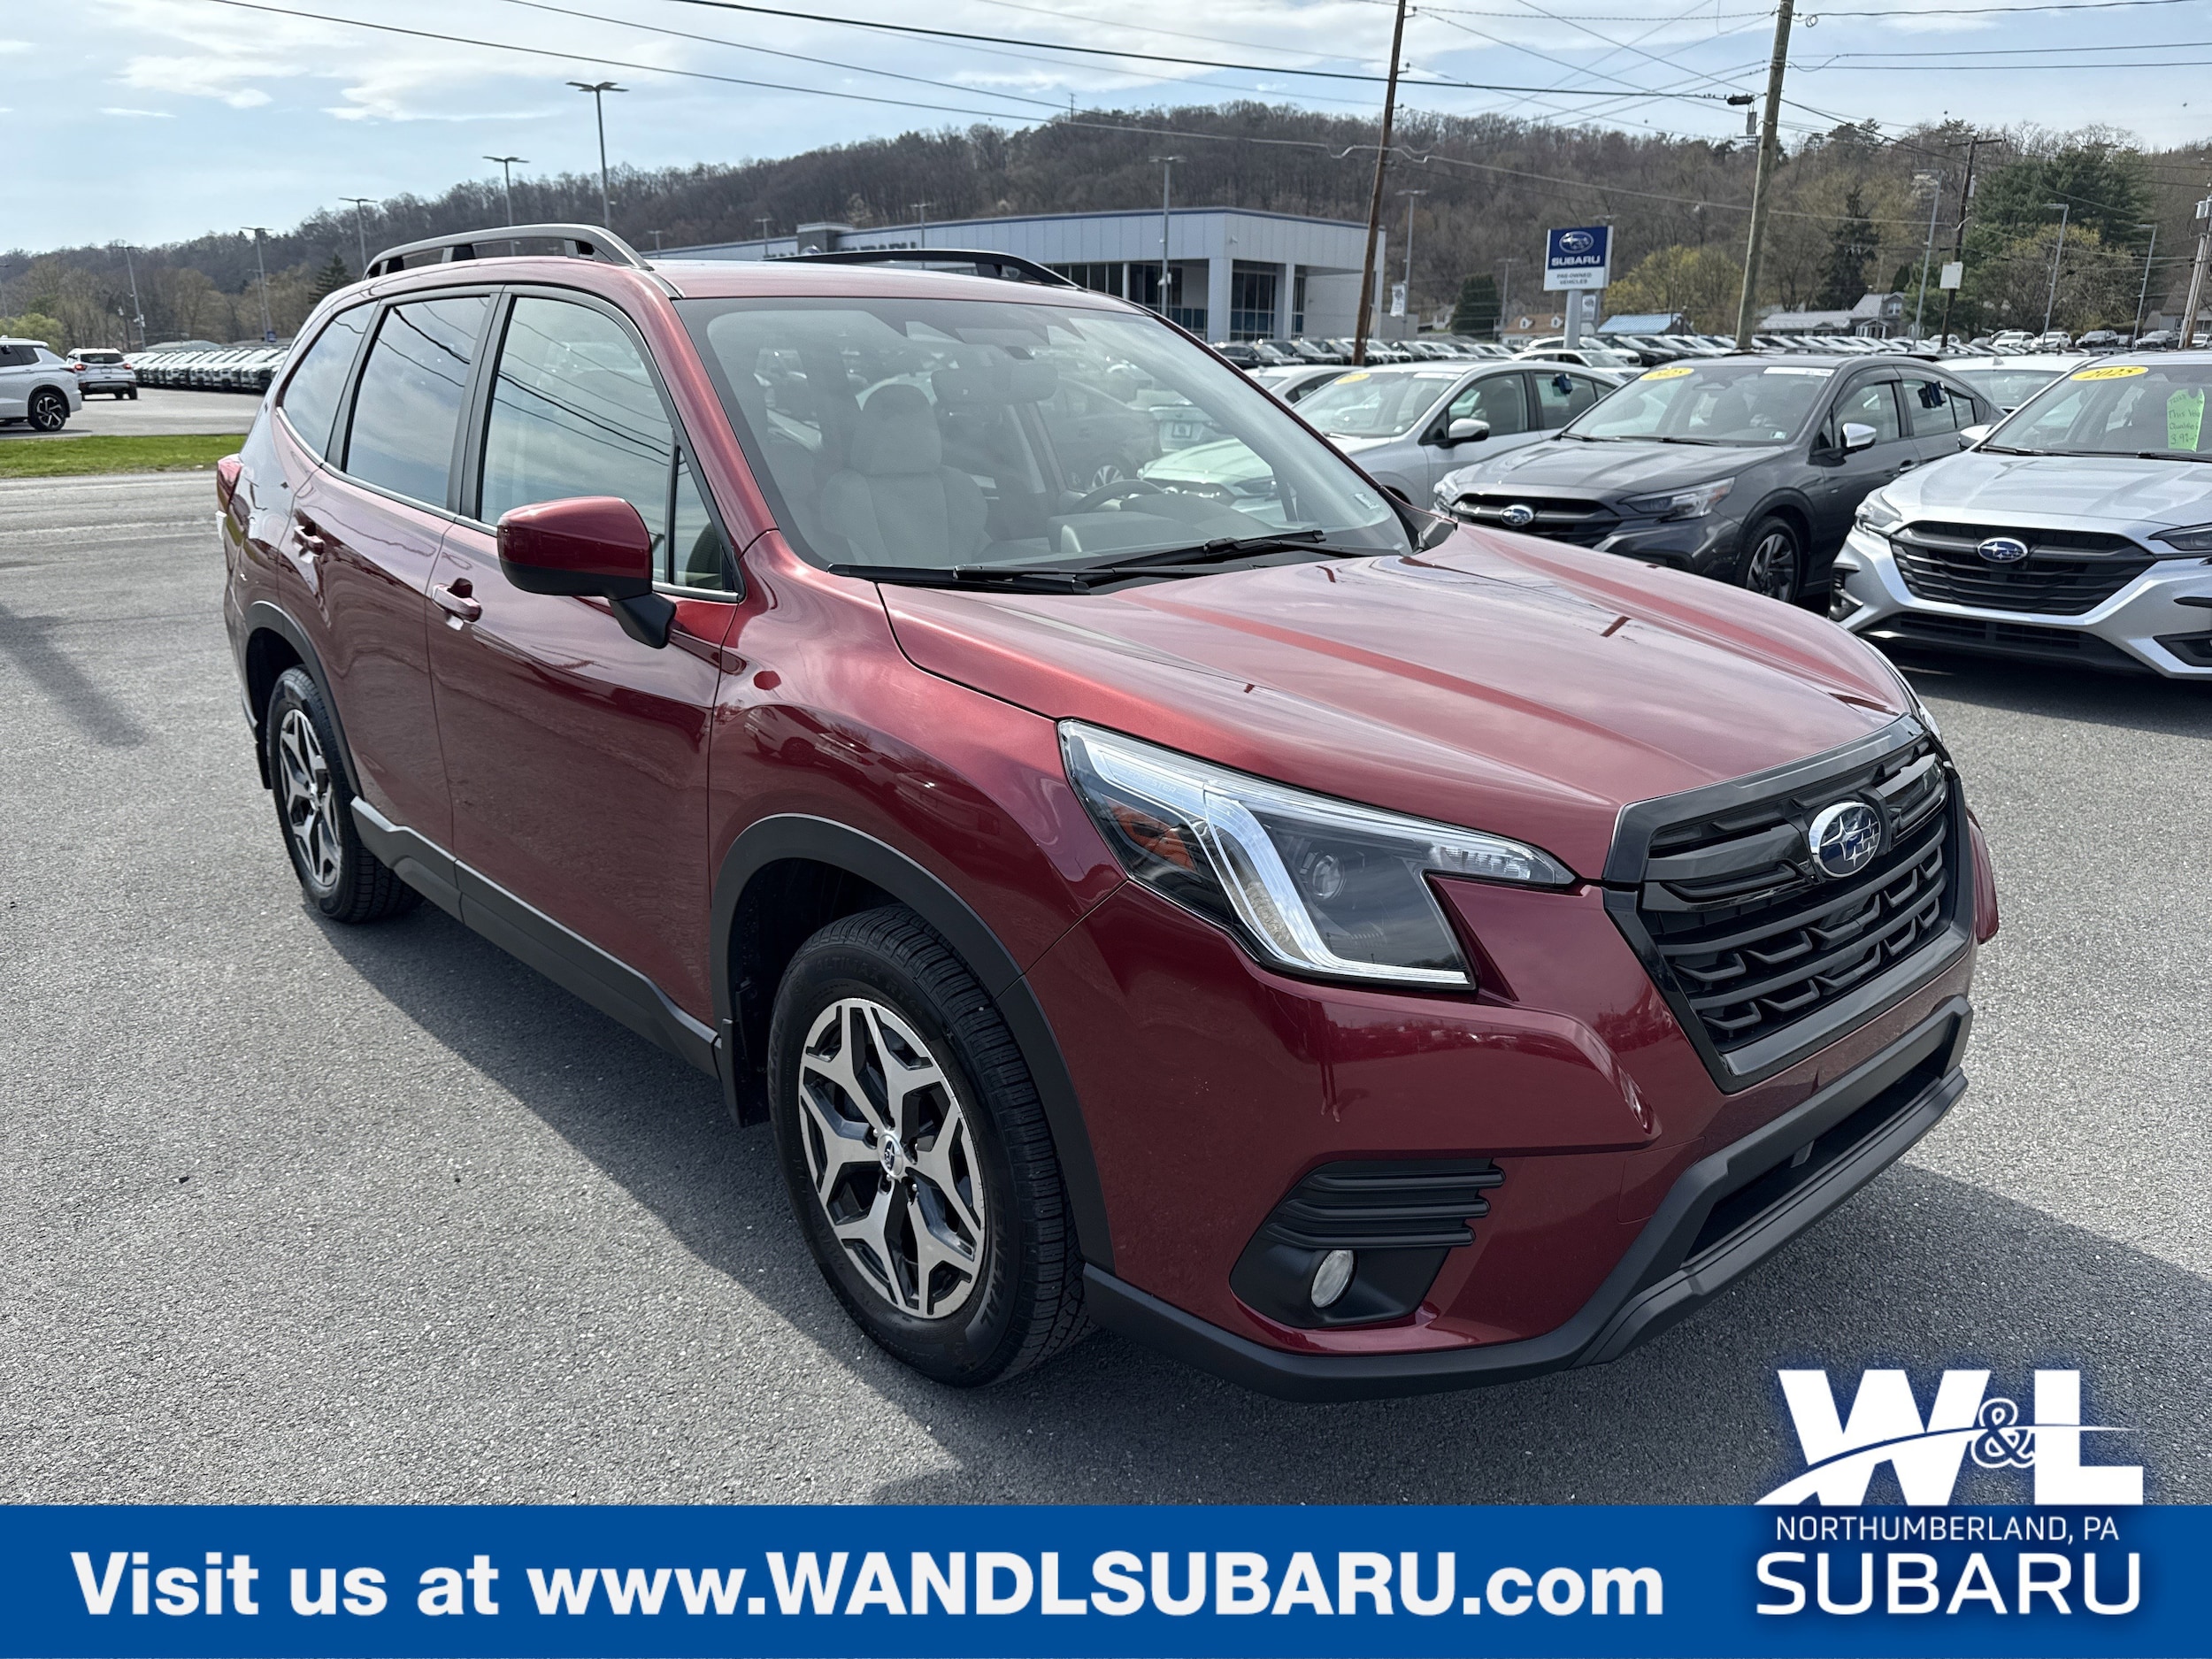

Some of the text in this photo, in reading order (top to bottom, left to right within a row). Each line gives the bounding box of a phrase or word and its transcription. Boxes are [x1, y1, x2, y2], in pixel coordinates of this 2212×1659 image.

[1551, 255, 1601, 266] SUBARU
[2081, 367, 2139, 379] 2025
[1126, 770, 1177, 794] FORESTER
[980, 1185, 1007, 1329] GENERAL
